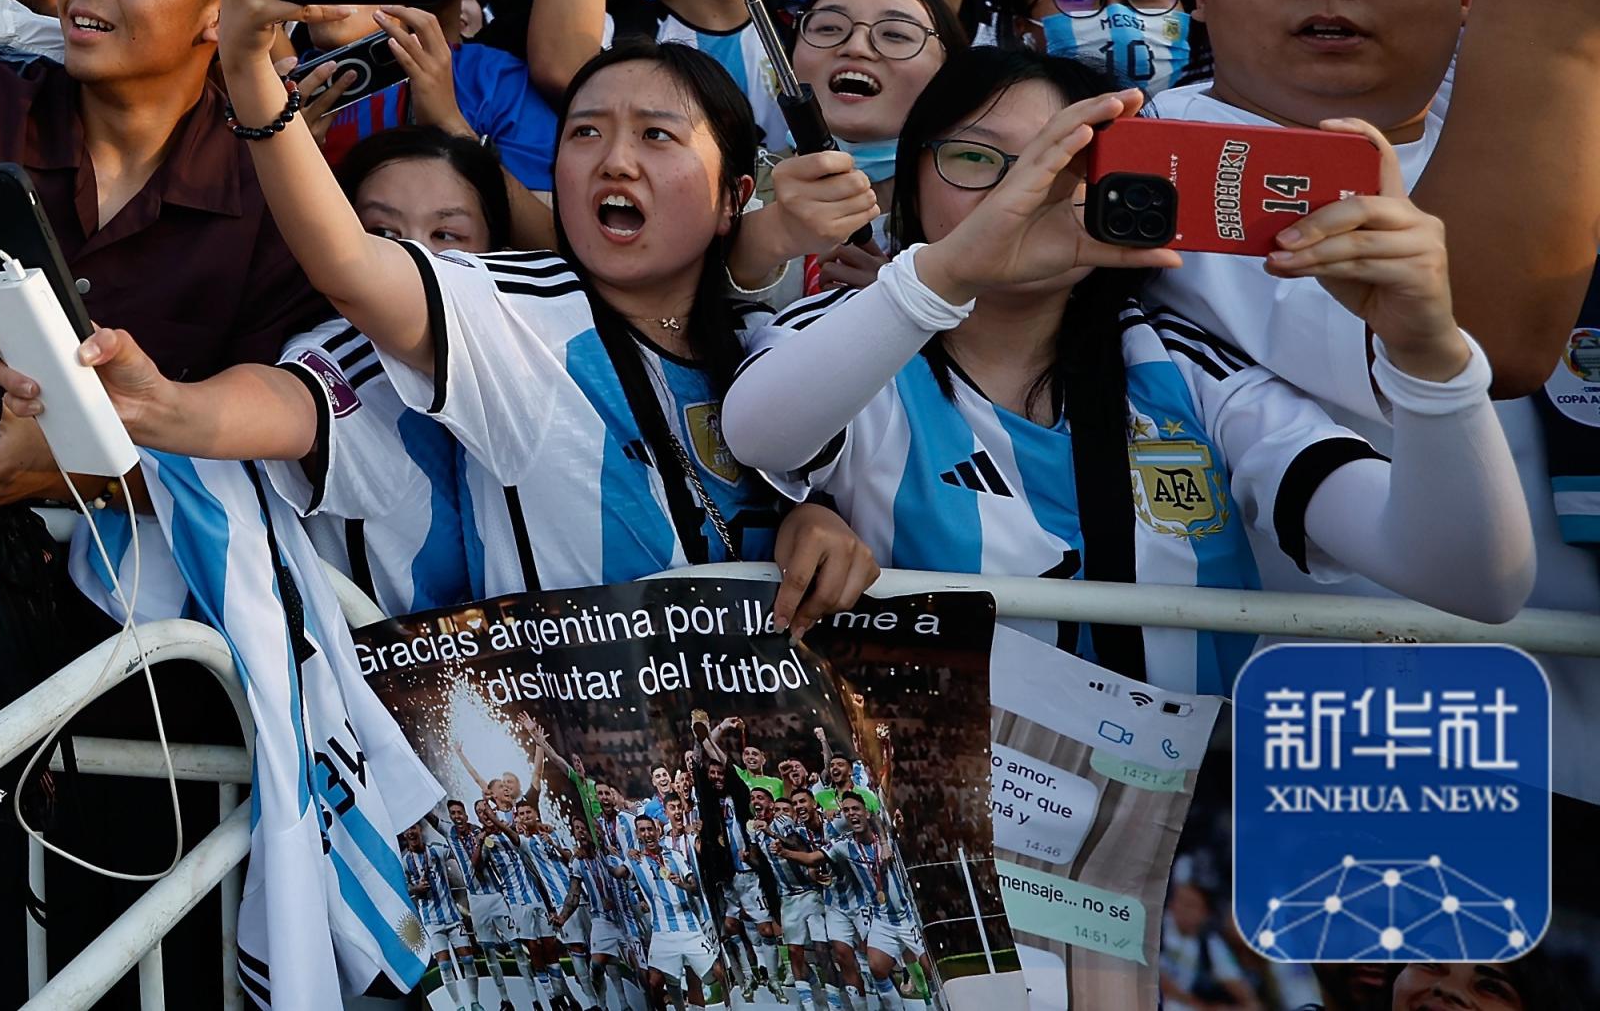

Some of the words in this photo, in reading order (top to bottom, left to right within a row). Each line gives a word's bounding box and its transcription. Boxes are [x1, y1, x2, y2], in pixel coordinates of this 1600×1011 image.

[1098, 40, 1156, 82] 10
[1215, 139, 1250, 241] SHOHOKU
[1262, 174, 1311, 215] 14
[1556, 394, 1588, 404] COPA
[1153, 466, 1207, 511] AFA
[353, 629, 480, 677] Gracias
[487, 605, 652, 656] argentina
[664, 602, 729, 643] por
[913, 612, 941, 636] a
[486, 662, 624, 706] disfrutar
[637, 651, 692, 696] del
[700, 647, 811, 695] fútbol
[1007, 758, 1058, 791] amor.
[1122, 765, 1159, 784] 14:21
[1001, 778, 1034, 802] Por
[1037, 794, 1074, 820] que
[1017, 811, 1032, 826] y
[1024, 838, 1062, 858] 14:46
[1082, 897, 1105, 914] no
[1109, 904, 1131, 923] sé
[1073, 924, 1109, 945] 14:51
